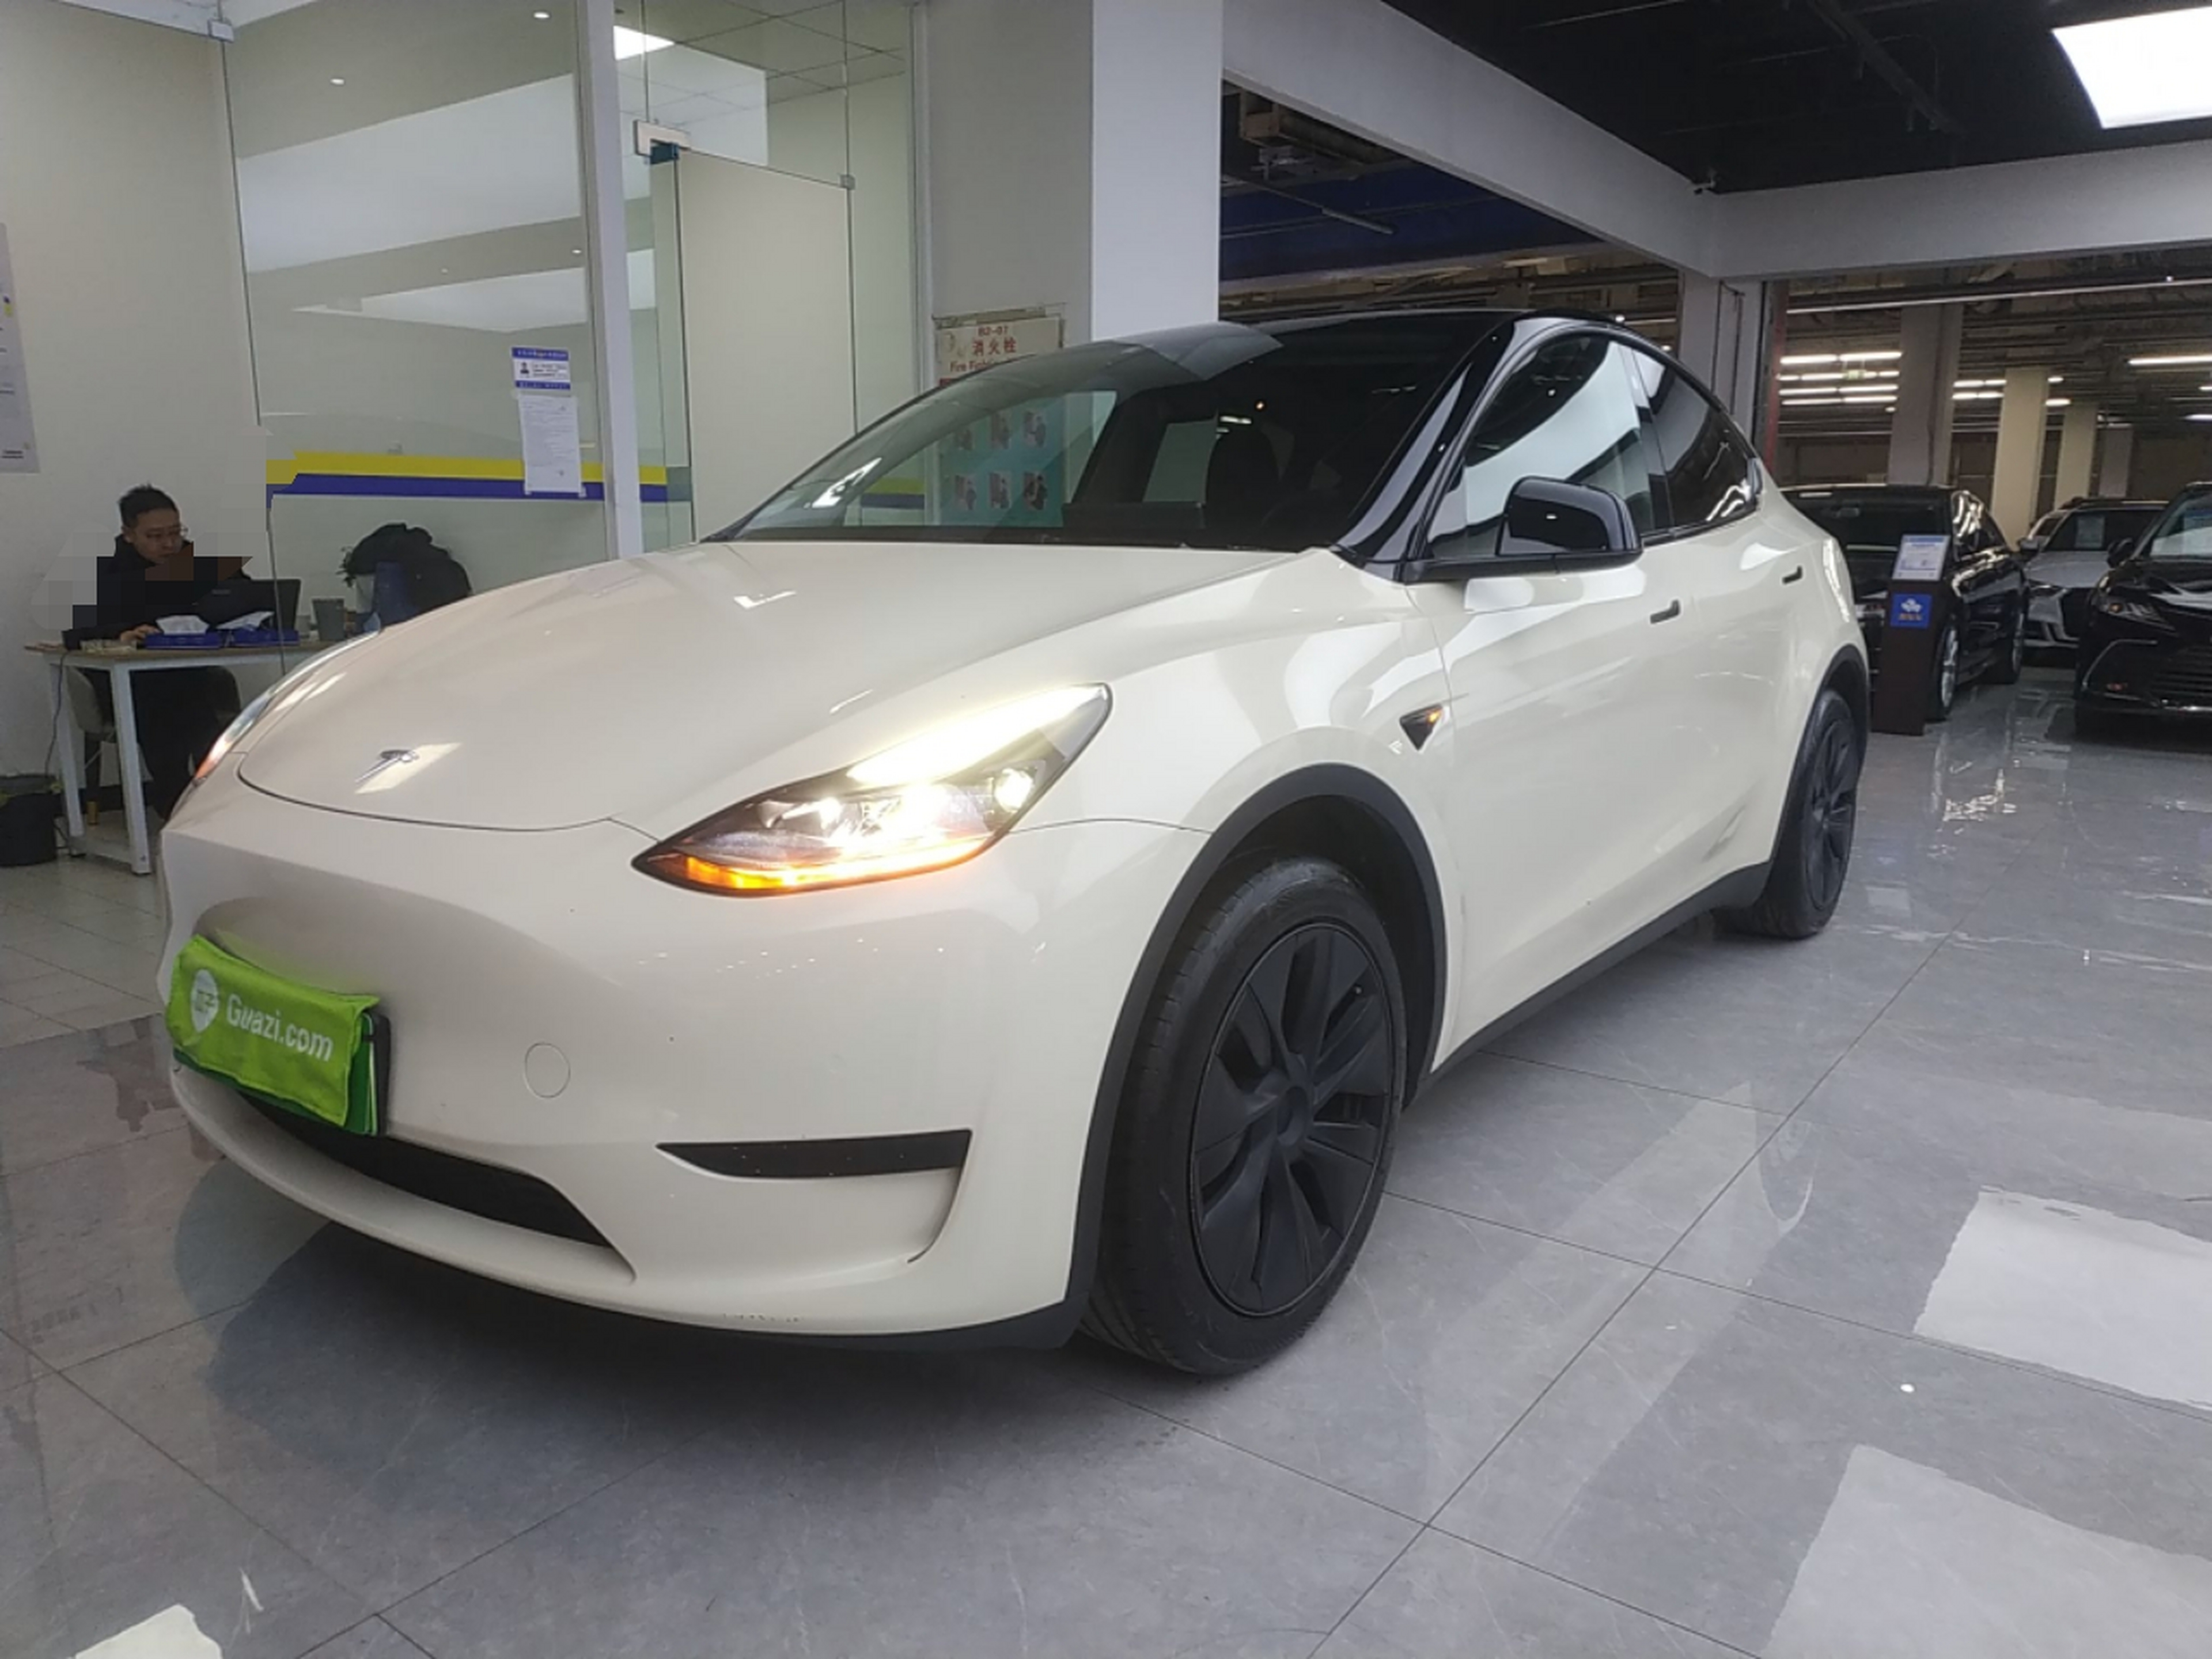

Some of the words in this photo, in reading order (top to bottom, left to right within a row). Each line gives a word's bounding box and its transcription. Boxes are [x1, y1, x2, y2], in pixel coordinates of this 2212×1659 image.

[972, 337, 1016, 356] 消火栓
[227, 993, 334, 1062] Guazi.com
